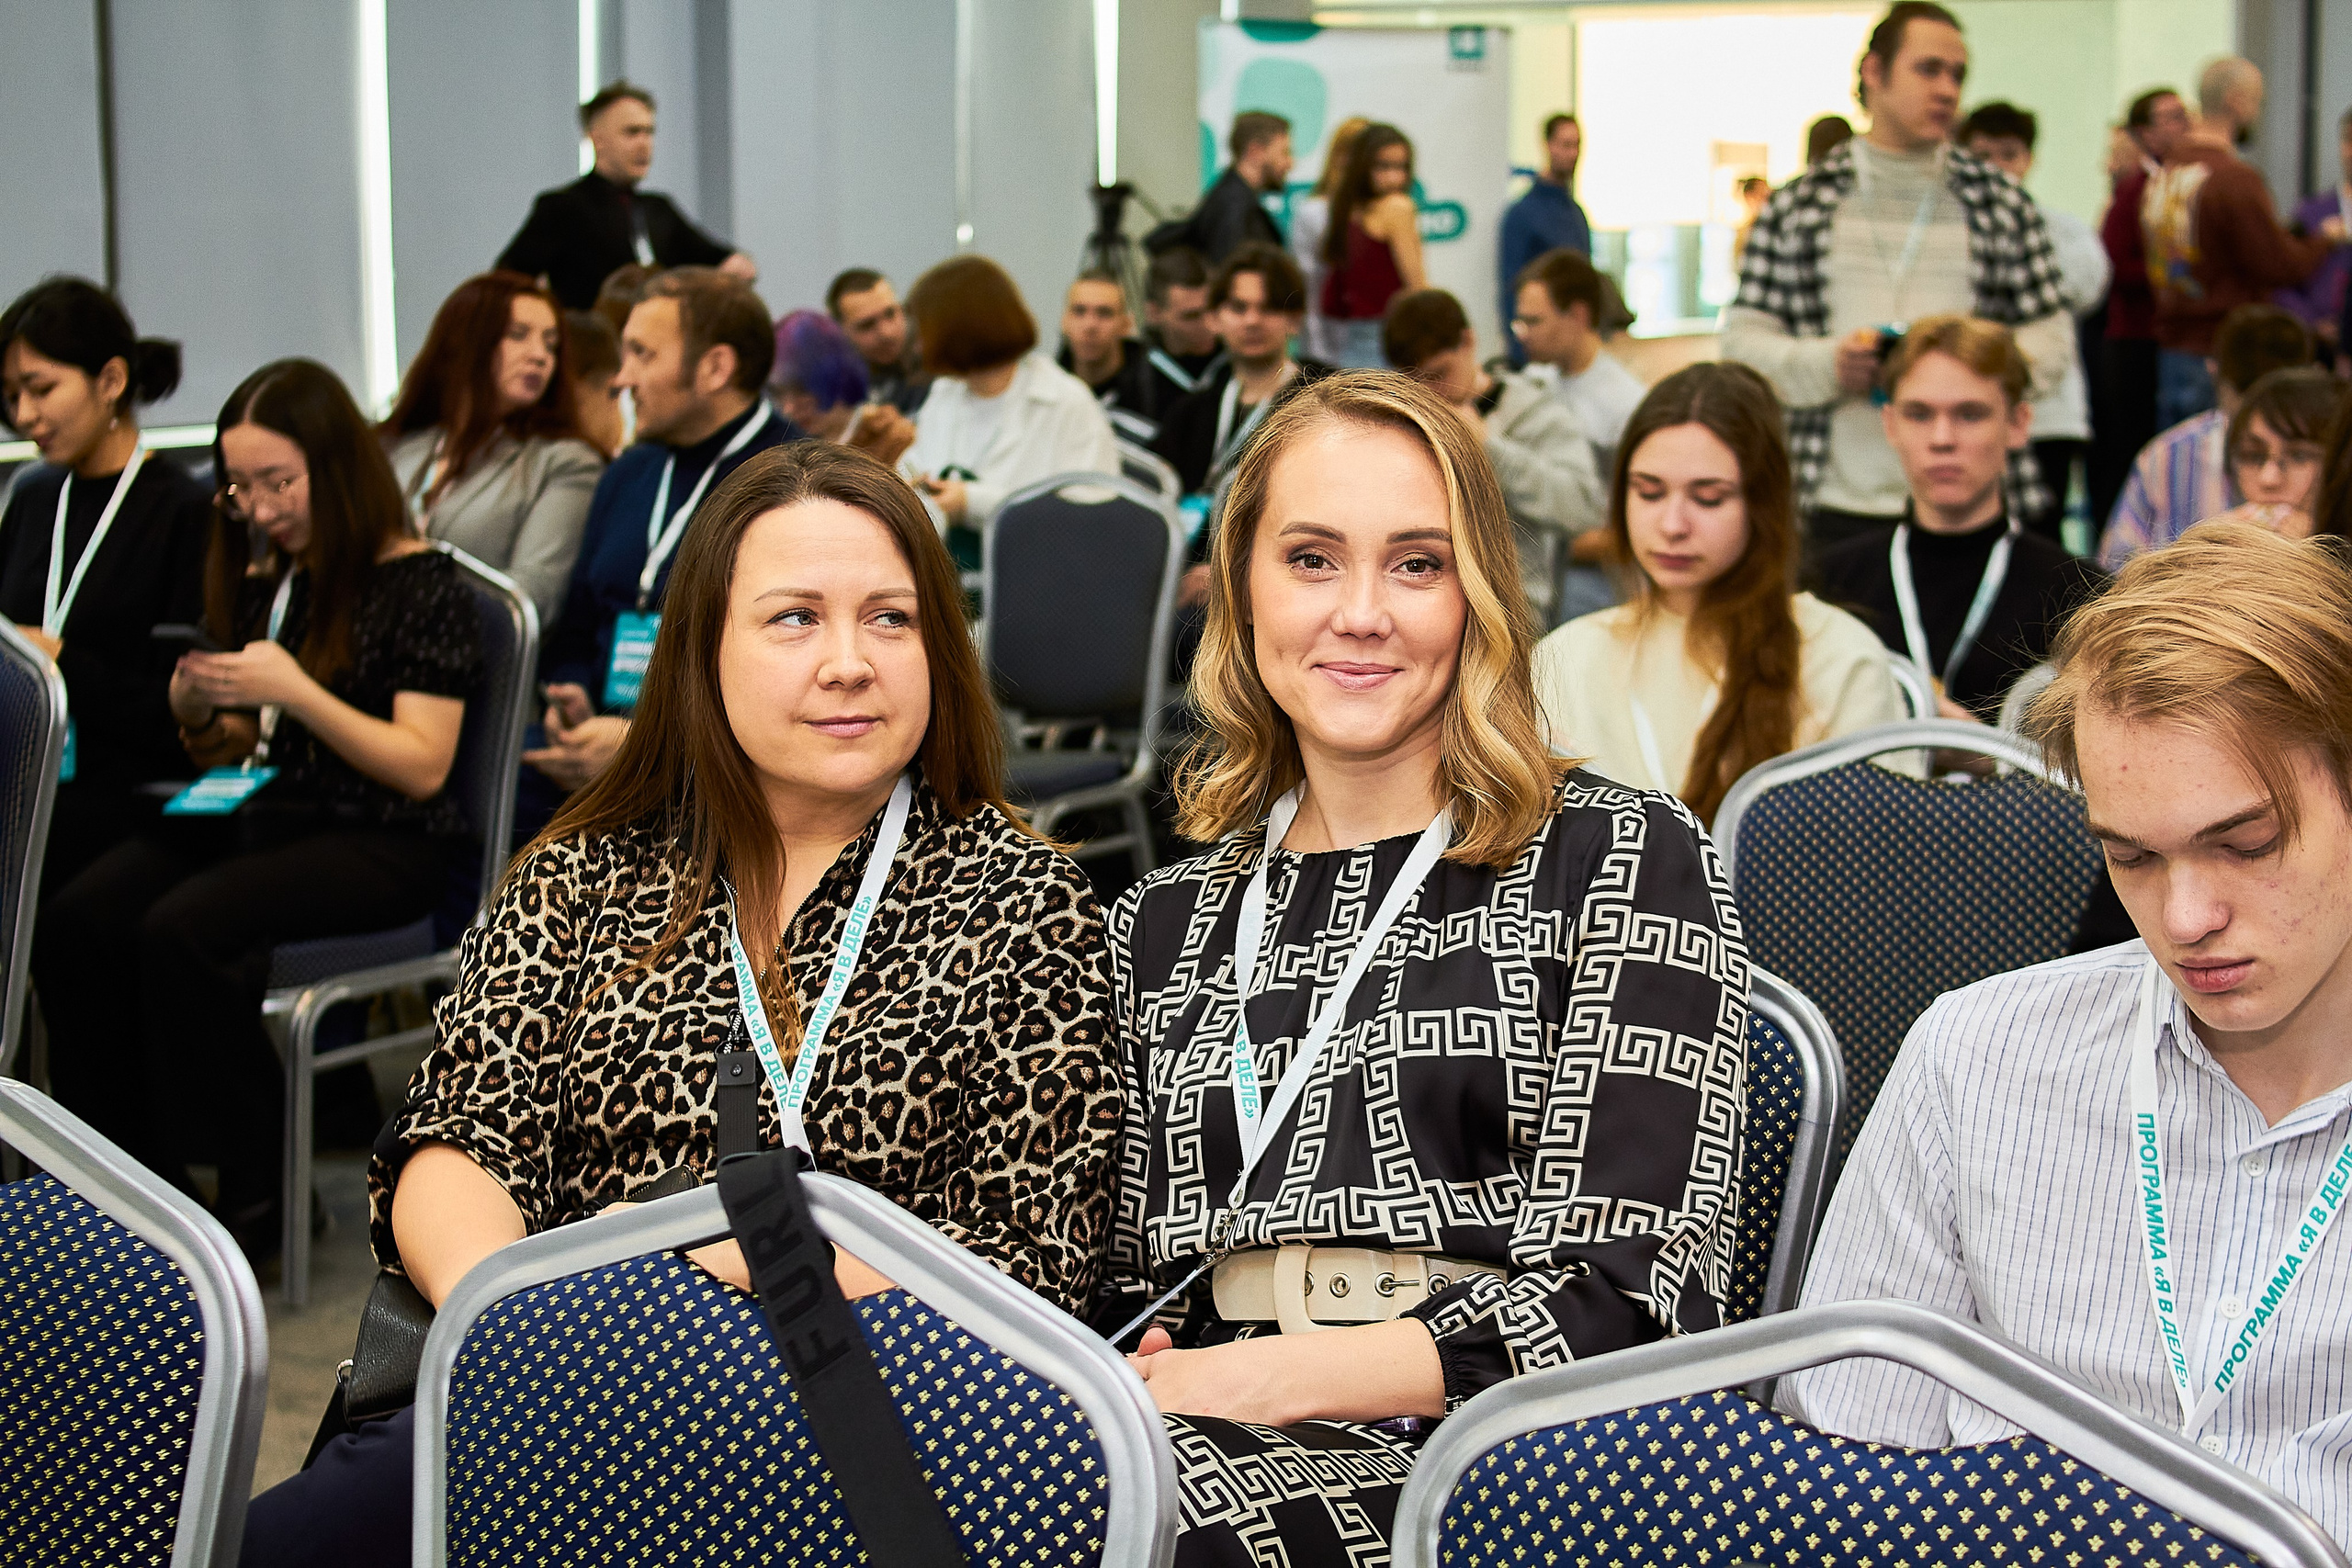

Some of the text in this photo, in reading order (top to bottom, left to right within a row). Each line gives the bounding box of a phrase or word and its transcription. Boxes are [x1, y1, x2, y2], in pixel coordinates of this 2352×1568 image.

[731, 931, 759, 1017] ГРАММА
[752, 1020, 767, 1040] «Я
[760, 1041, 773, 1056] В
[787, 896, 872, 1108] ПРОГРАММА «Я В ДЕЛЕ»
[1236, 1039, 1247, 1054] В
[1235, 1057, 1259, 1119] ДЕЛЕ»
[2137, 1112, 2188, 1388] ПРОГРАММА «Я В ДЕЛЕ»
[2214, 1253, 2303, 1393] ПРОГРАММА
[2298, 1223, 2318, 1253] «Я
[2309, 1205, 2328, 1226] В
